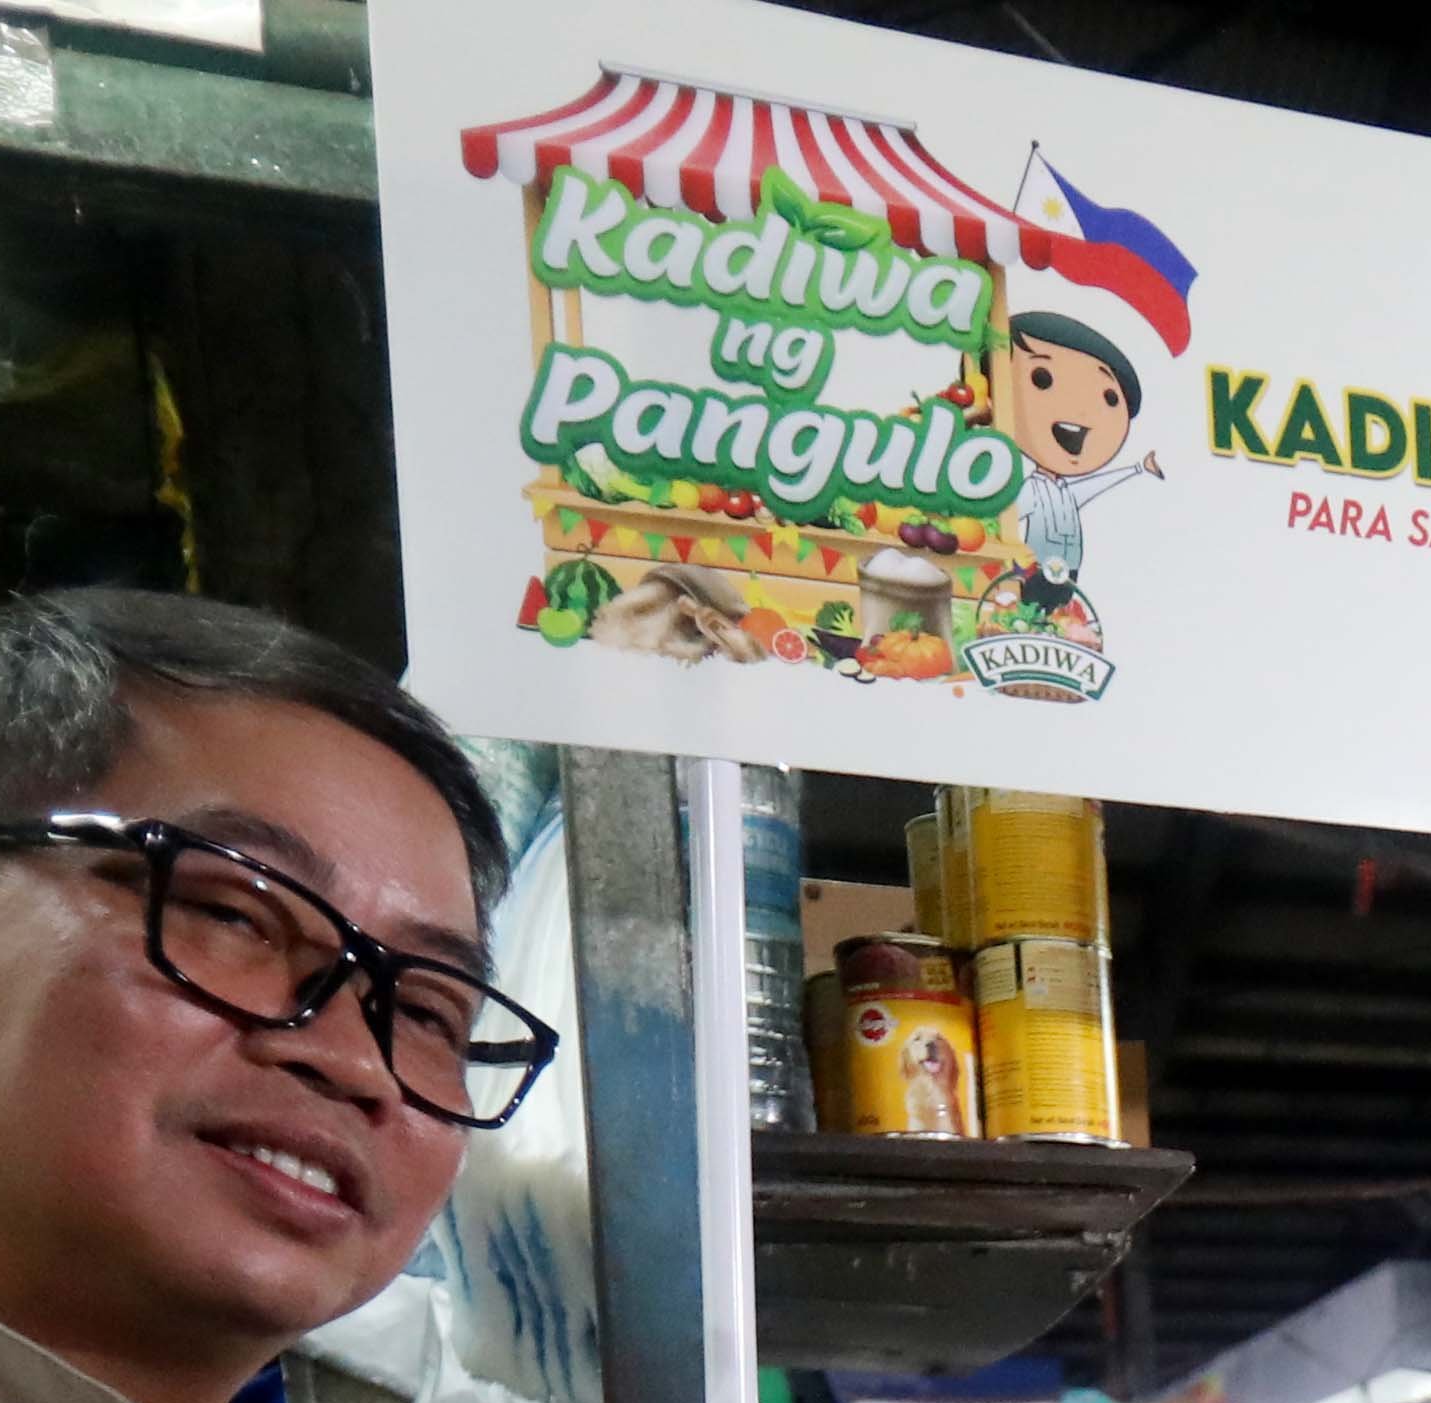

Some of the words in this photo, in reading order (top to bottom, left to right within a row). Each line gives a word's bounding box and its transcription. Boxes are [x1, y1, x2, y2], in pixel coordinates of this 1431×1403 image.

[540, 174, 986, 336] Kadiwa
[721, 316, 823, 381] ng
[530, 354, 1017, 505] Pangulo
[1286, 491, 1394, 545] PARA
[979, 643, 1100, 688] KADIWA
